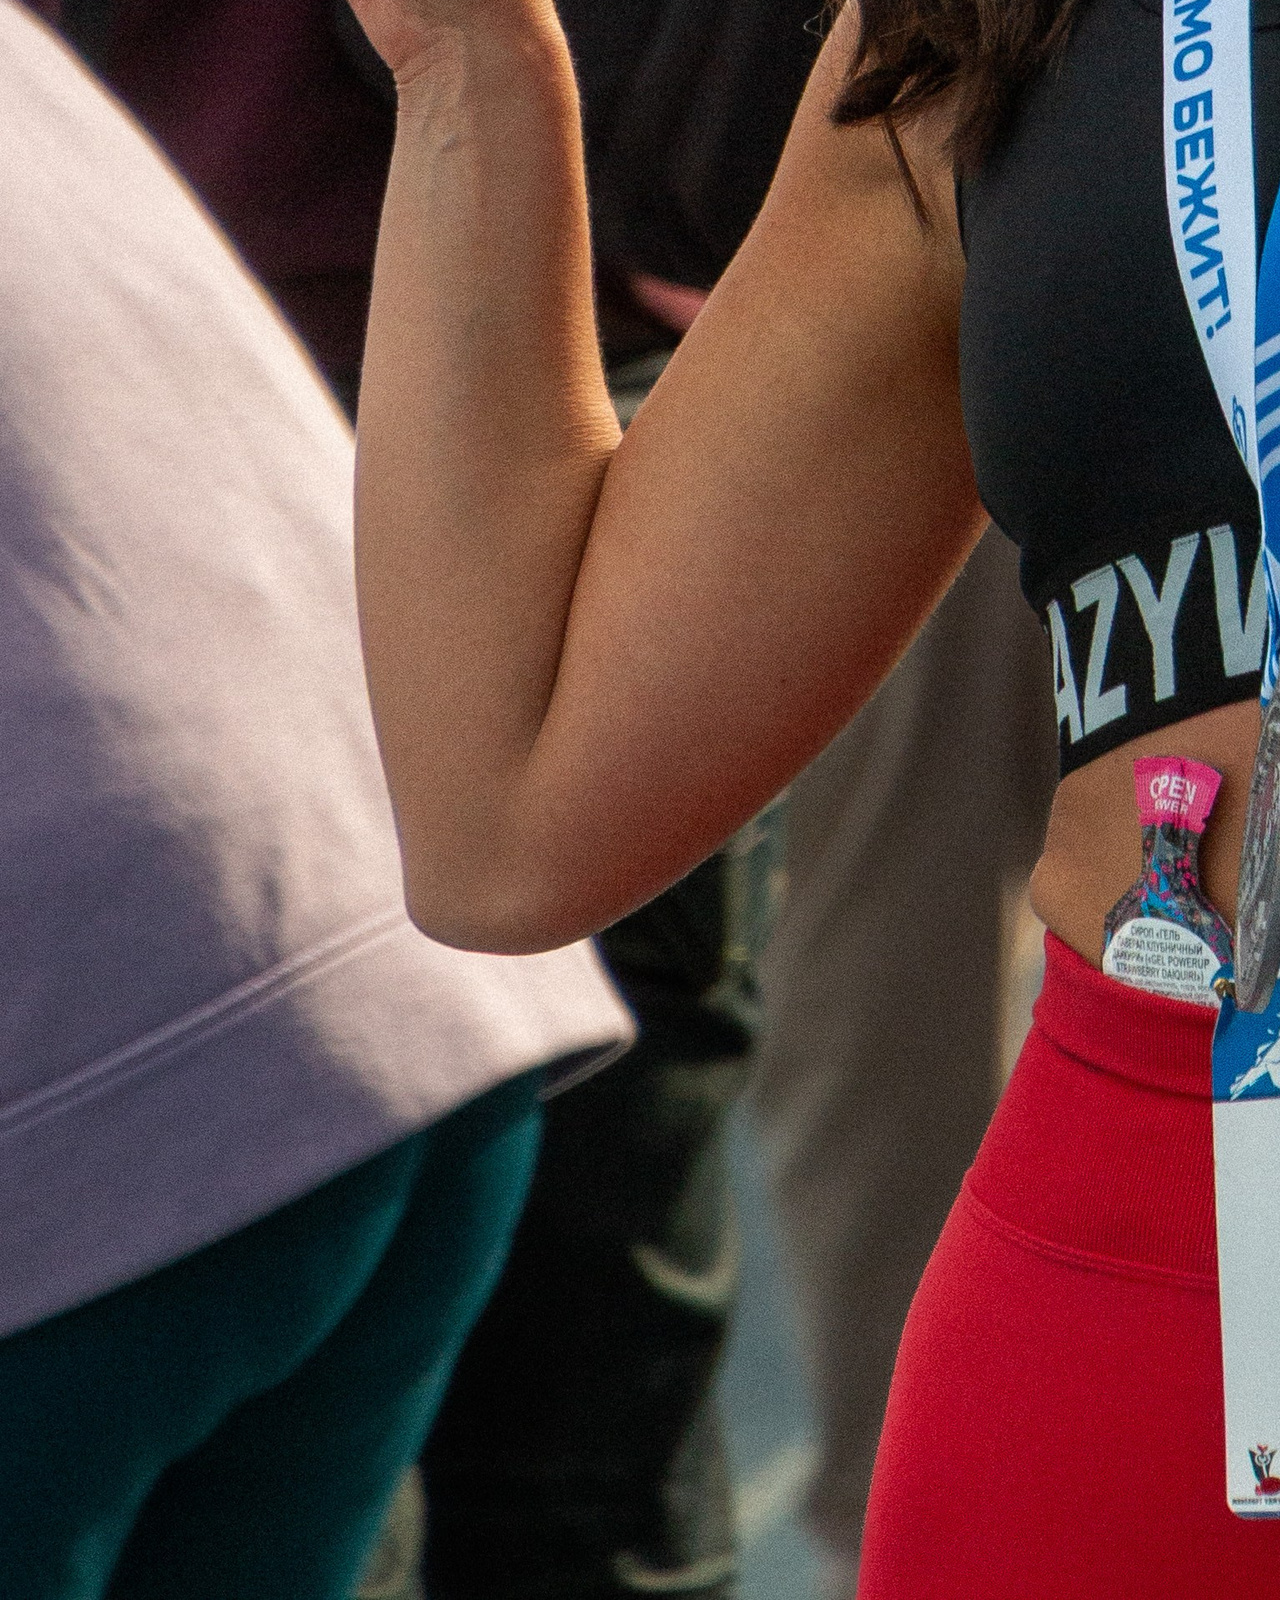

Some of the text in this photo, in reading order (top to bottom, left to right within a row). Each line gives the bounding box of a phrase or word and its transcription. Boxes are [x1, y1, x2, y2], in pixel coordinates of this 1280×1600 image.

[1173, 88, 1232, 340] БЕЖИТ!
[1131, 926, 1154, 939] СИРОП
[1168, 955, 1210, 970] POWERUP
